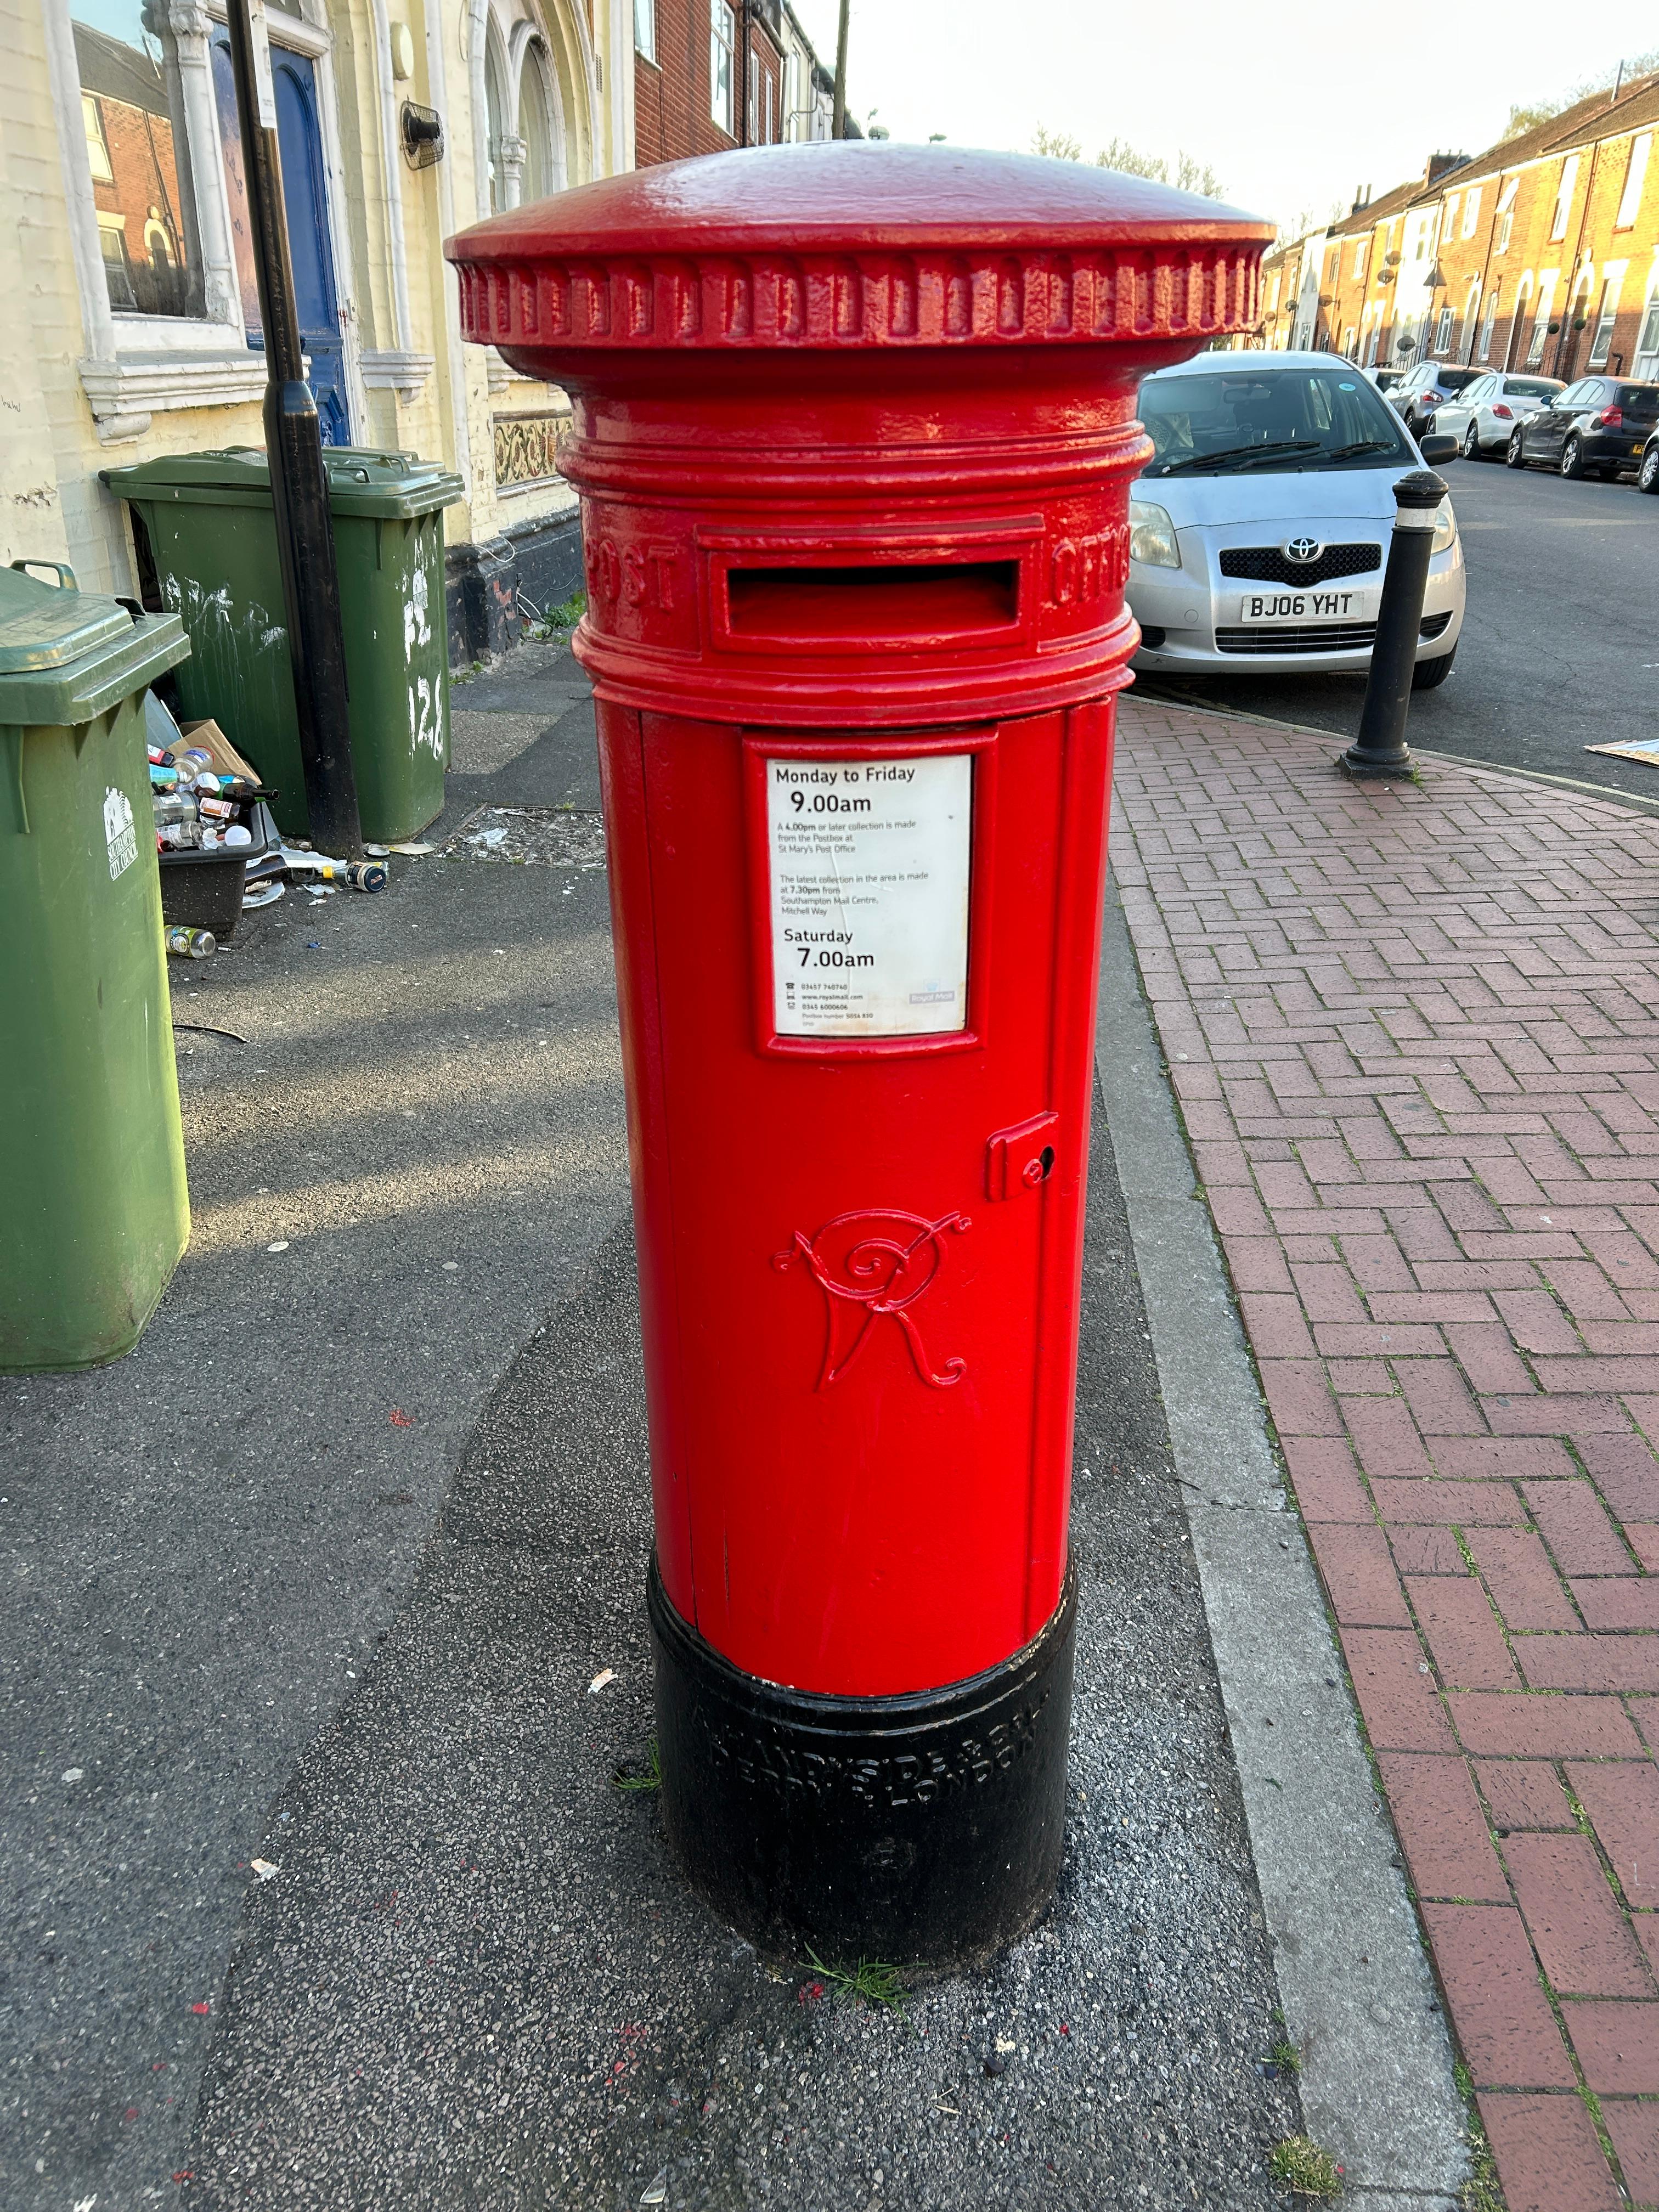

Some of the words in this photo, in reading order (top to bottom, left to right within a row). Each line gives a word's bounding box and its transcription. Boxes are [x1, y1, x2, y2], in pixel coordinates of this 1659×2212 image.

[1250, 596, 1305, 617] BJ06
[1312, 594, 1353, 614] YHT
[776, 768, 837, 786] Monday
[844, 770, 859, 782] to
[866, 766, 915, 782] Friday
[791, 791, 871, 812] 9.00am
[777, 822, 783, 831] A
[785, 822, 816, 833] 4.00pm
[828, 822, 845, 832] later
[848, 821, 884, 831] collection
[886, 820, 892, 830] is
[894, 819, 916, 829] made
[778, 833, 797, 843] from
[798, 833, 811, 843] the
[813, 833, 843, 843] Postbox
[845, 833, 853, 842] at
[778, 844, 787, 853] St
[789, 844, 813, 855] Mary's
[815, 844, 832, 854] Post
[834, 844, 856, 854] Office
[110, 857, 121, 880] CITY
[120, 840, 138, 869] COUNCIL
[780, 874, 795, 884] The
[797, 875, 817, 884] latest
[819, 874, 854, 884] collection
[856, 874, 864, 883] in
[865, 874, 878, 883] the
[880, 874, 896, 882] area
[899, 872, 905, 881] is
[907, 871, 928, 881] made
[780, 886, 788, 894] at
[790, 885, 820, 896] 7.30pm
[822, 885, 840, 895] from
[781, 895, 832, 906] Southampton
[833, 896, 849, 905] Mail
[781, 906, 810, 916] Mitchell
[811, 906, 827, 917] Way
[785, 928, 853, 945] Saturday
[797, 947, 874, 968] 7.00am
